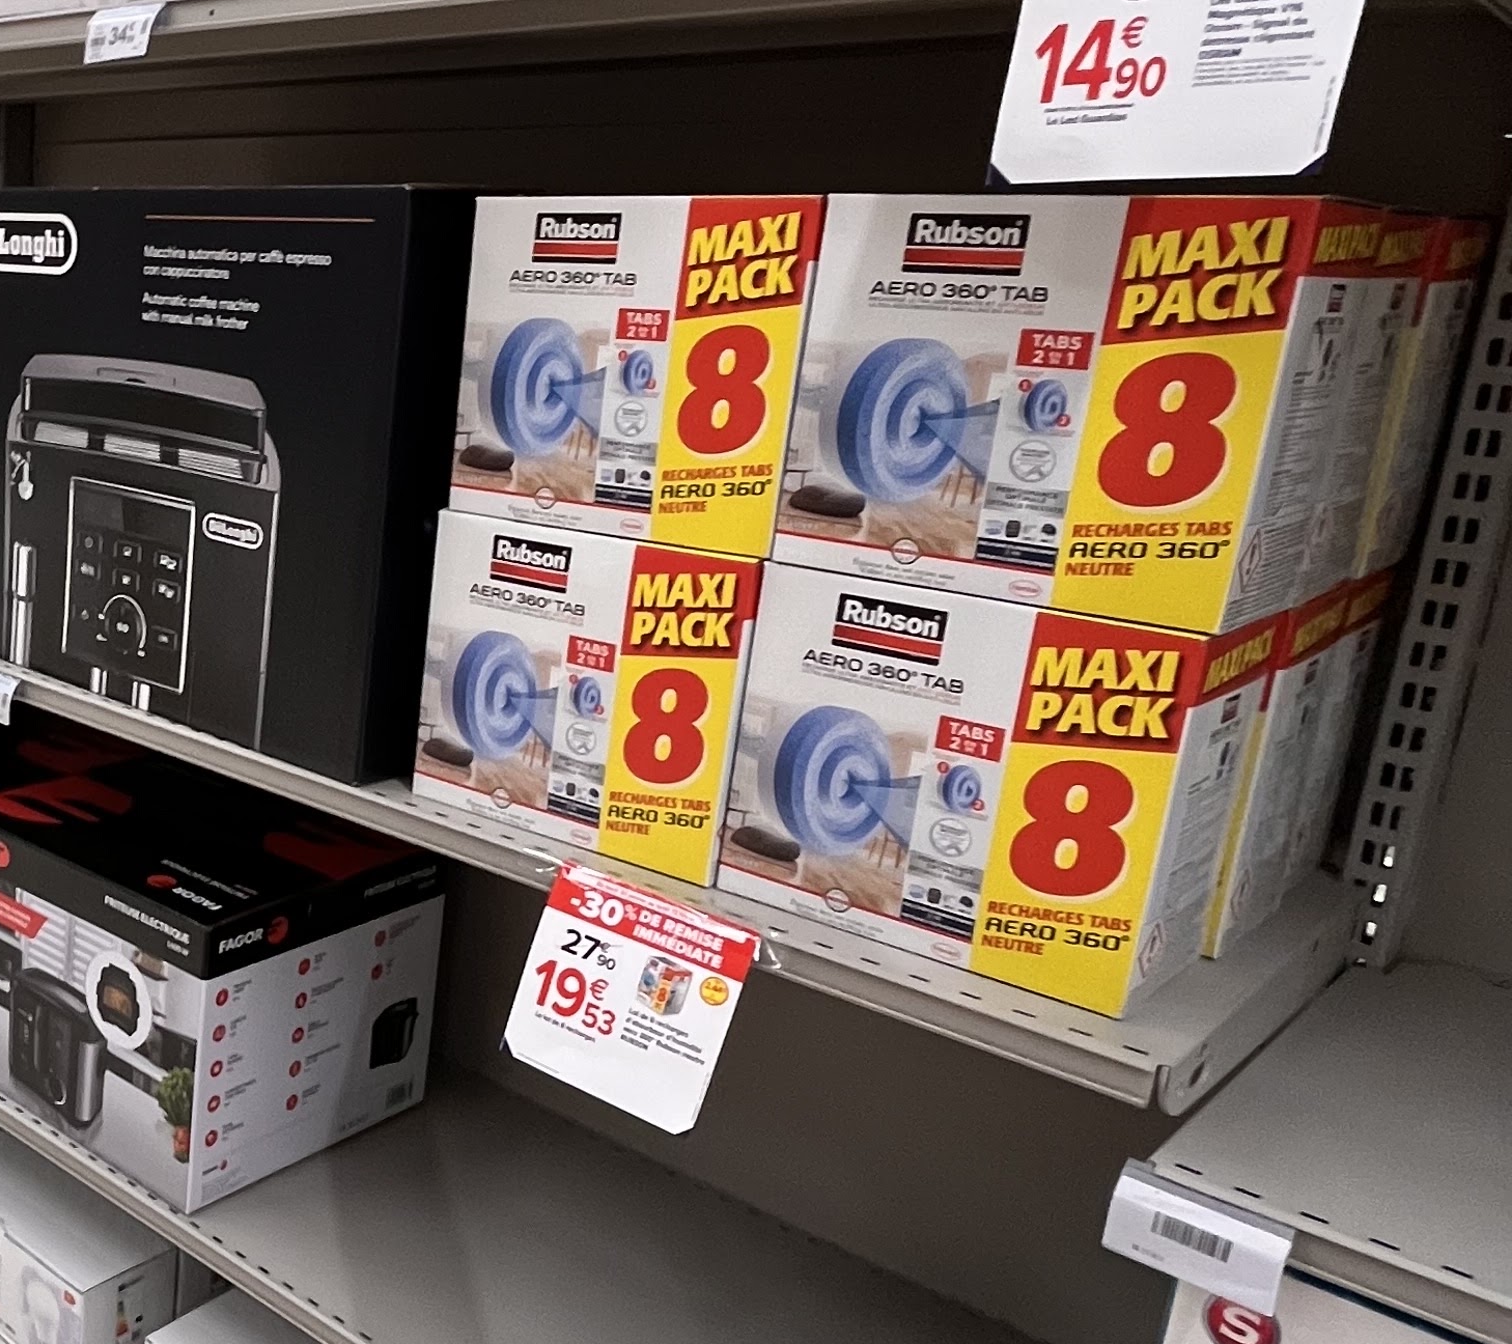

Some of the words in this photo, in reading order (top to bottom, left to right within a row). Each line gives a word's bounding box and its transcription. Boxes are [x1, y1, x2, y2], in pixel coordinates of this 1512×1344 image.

[1035, 19, 1116, 104] 14
[1121, 16, 1148, 48] €
[1113, 56, 1166, 98] 90
[538, 217, 618, 239] Rubson
[686, 211, 802, 266] MAXI
[914, 219, 1024, 246] Rubson
[1122, 215, 1291, 280] MAXI
[509, 270, 557, 285] AERO
[603, 272, 637, 286] TAB
[684, 256, 797, 307] PACK
[870, 281, 937, 297] AERO
[1001, 285, 1049, 302] TAB
[1117, 268, 1286, 330] PACK
[1032, 333, 1083, 350] TABS
[677, 324, 771, 455] 8
[1097, 351, 1238, 508] 8
[661, 466, 737, 482] RECHARGES
[740, 463, 773, 478] TABS
[658, 500, 707, 515] NEUTRE
[660, 483, 716, 499] AERO
[1071, 522, 1180, 538] RECHARGES
[1185, 520, 1233, 536] TABS
[495, 539, 567, 572] Rubson
[1068, 540, 1147, 559] AERO
[1064, 561, 1134, 577] NEUTRE
[469, 583, 515, 607] AERO
[554, 601, 585, 617] TAB
[631, 572, 737, 609] MAXI
[629, 611, 731, 648] PACK
[842, 597, 940, 639] Rubson
[803, 648, 864, 674] AERO
[922, 673, 965, 696] TAB
[1030, 645, 1181, 694] MAXI
[623, 668, 709, 784] 8
[1025, 691, 1177, 739] PACK
[949, 722, 995, 742] TABS
[607, 804, 658, 823] AERO
[609, 790, 679, 809] RECHARGES
[680, 798, 712, 813] TABS
[605, 819, 651, 836] NEUTRE
[1009, 759, 1135, 897] 8
[639, 910, 661, 926] DE
[663, 917, 724, 951] REMISE
[984, 918, 1054, 943] AERO
[987, 900, 1083, 927] RECHARGES
[1089, 916, 1133, 933] TABS
[218, 928, 263, 954] FAGOR
[561, 928, 600, 960] 27
[632, 924, 724, 969] IMMÉDIATE
[980, 934, 1044, 957] NEUTRE
[597, 955, 616, 970] 90
[535, 960, 586, 1017] 19
[582, 1004, 616, 1036] 53
